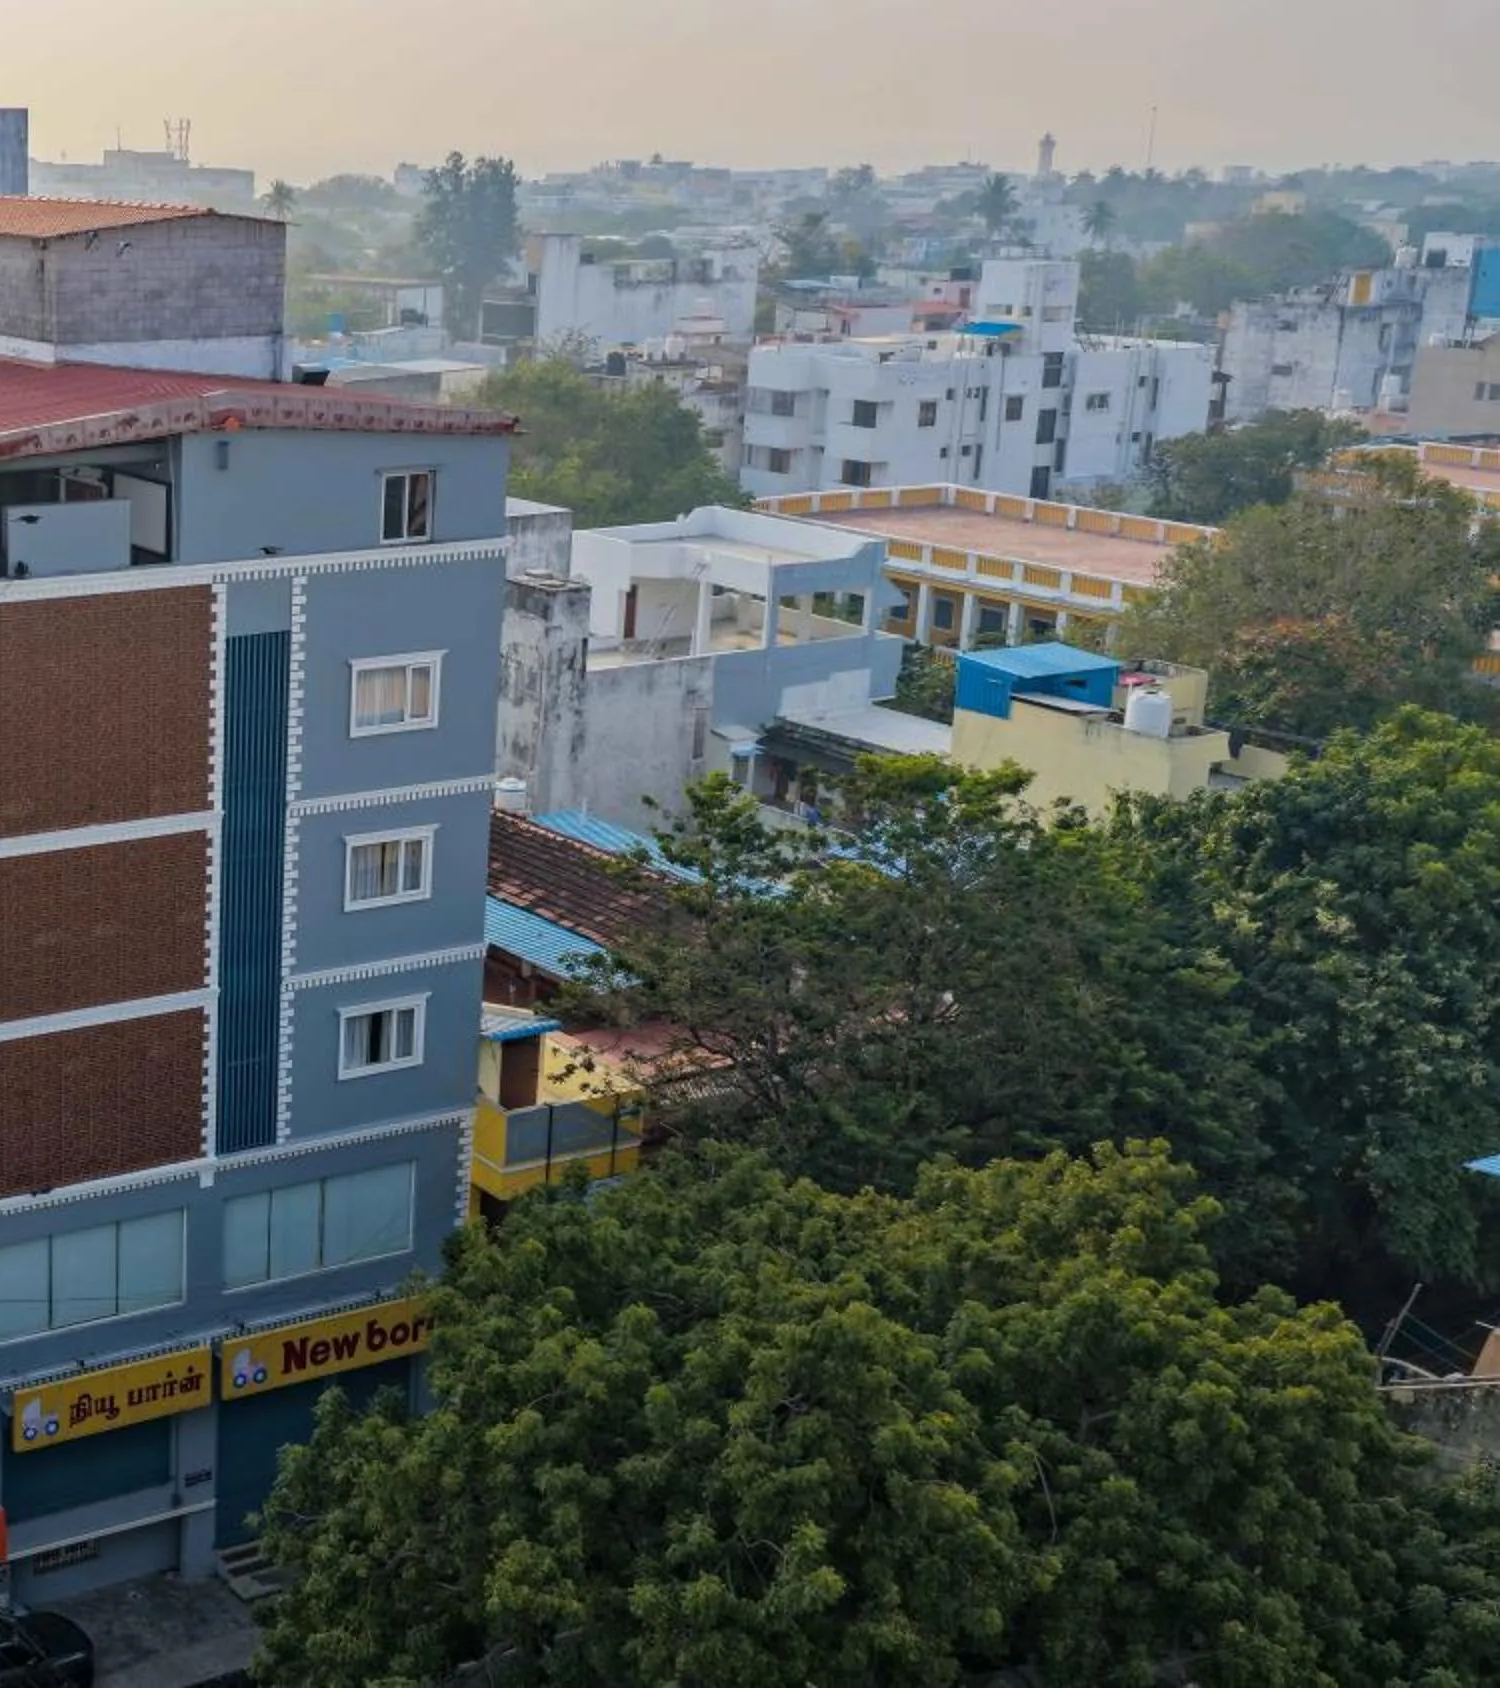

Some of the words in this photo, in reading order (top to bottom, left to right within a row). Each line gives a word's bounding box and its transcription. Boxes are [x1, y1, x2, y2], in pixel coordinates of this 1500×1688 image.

[280, 1331, 361, 1375] New
[68, 1393, 121, 1429] நியூ
[126, 1365, 205, 1407] பார்ன்
